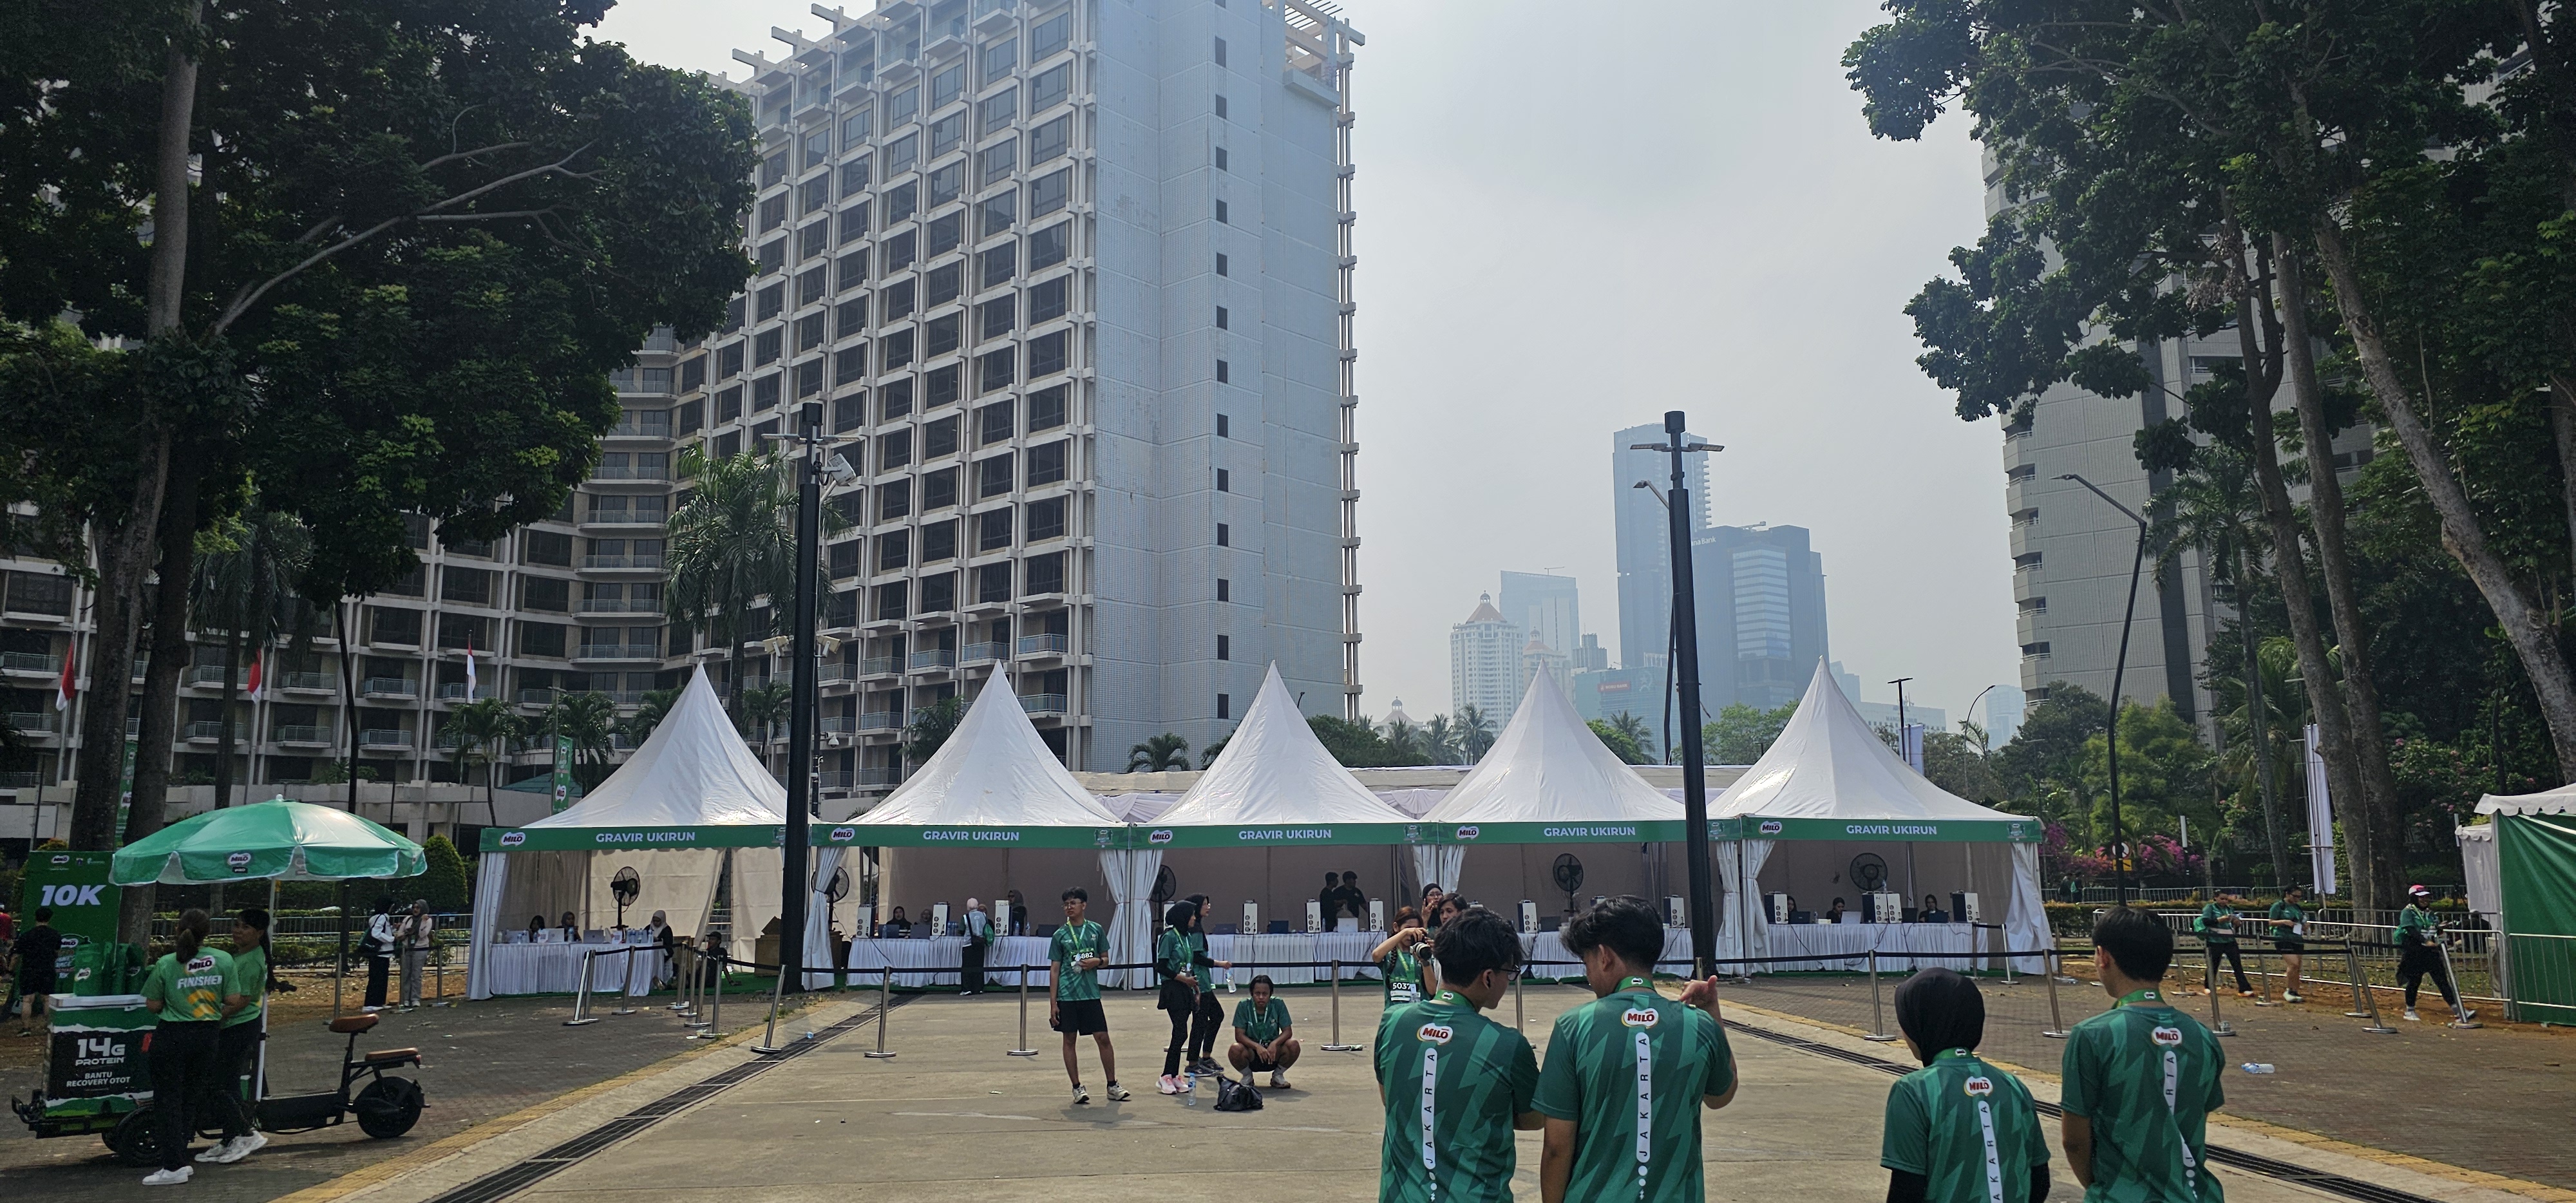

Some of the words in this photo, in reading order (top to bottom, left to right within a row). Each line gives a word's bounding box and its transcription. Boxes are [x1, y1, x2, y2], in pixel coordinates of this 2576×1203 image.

[1701, 536, 1716, 545] Bank
[1238, 830, 1283, 840] GRAVIR
[1286, 829, 1332, 838] UKIRUN
[1544, 828, 1587, 837] GRAVIR
[1590, 827, 1636, 836] UKIRUN
[1846, 825, 1889, 834] GRAVIR
[1892, 826, 1937, 835] UKIRUN
[596, 833, 643, 842] GRAVIR
[647, 832, 695, 842] UKIRUN
[923, 831, 969, 840] GRAVIR
[972, 831, 1019, 840] UKIRUN
[41, 885, 107, 906] 10K
[189, 960, 212, 971] MILO
[1627, 1013, 1655, 1022] MILO
[1423, 1027, 1448, 1039] MILO
[2155, 1032, 2179, 1040] MILO
[75, 1057, 125, 1066] PROTEIN
[66, 1078, 108, 1087] RECOVERY
[1969, 1082, 1989, 1090] MILO
[1639, 1038, 1649, 1157] JAKARTA
[1424, 1054, 1435, 1164] JAKARTA
[1981, 1106, 2001, 1200] AKARTA
